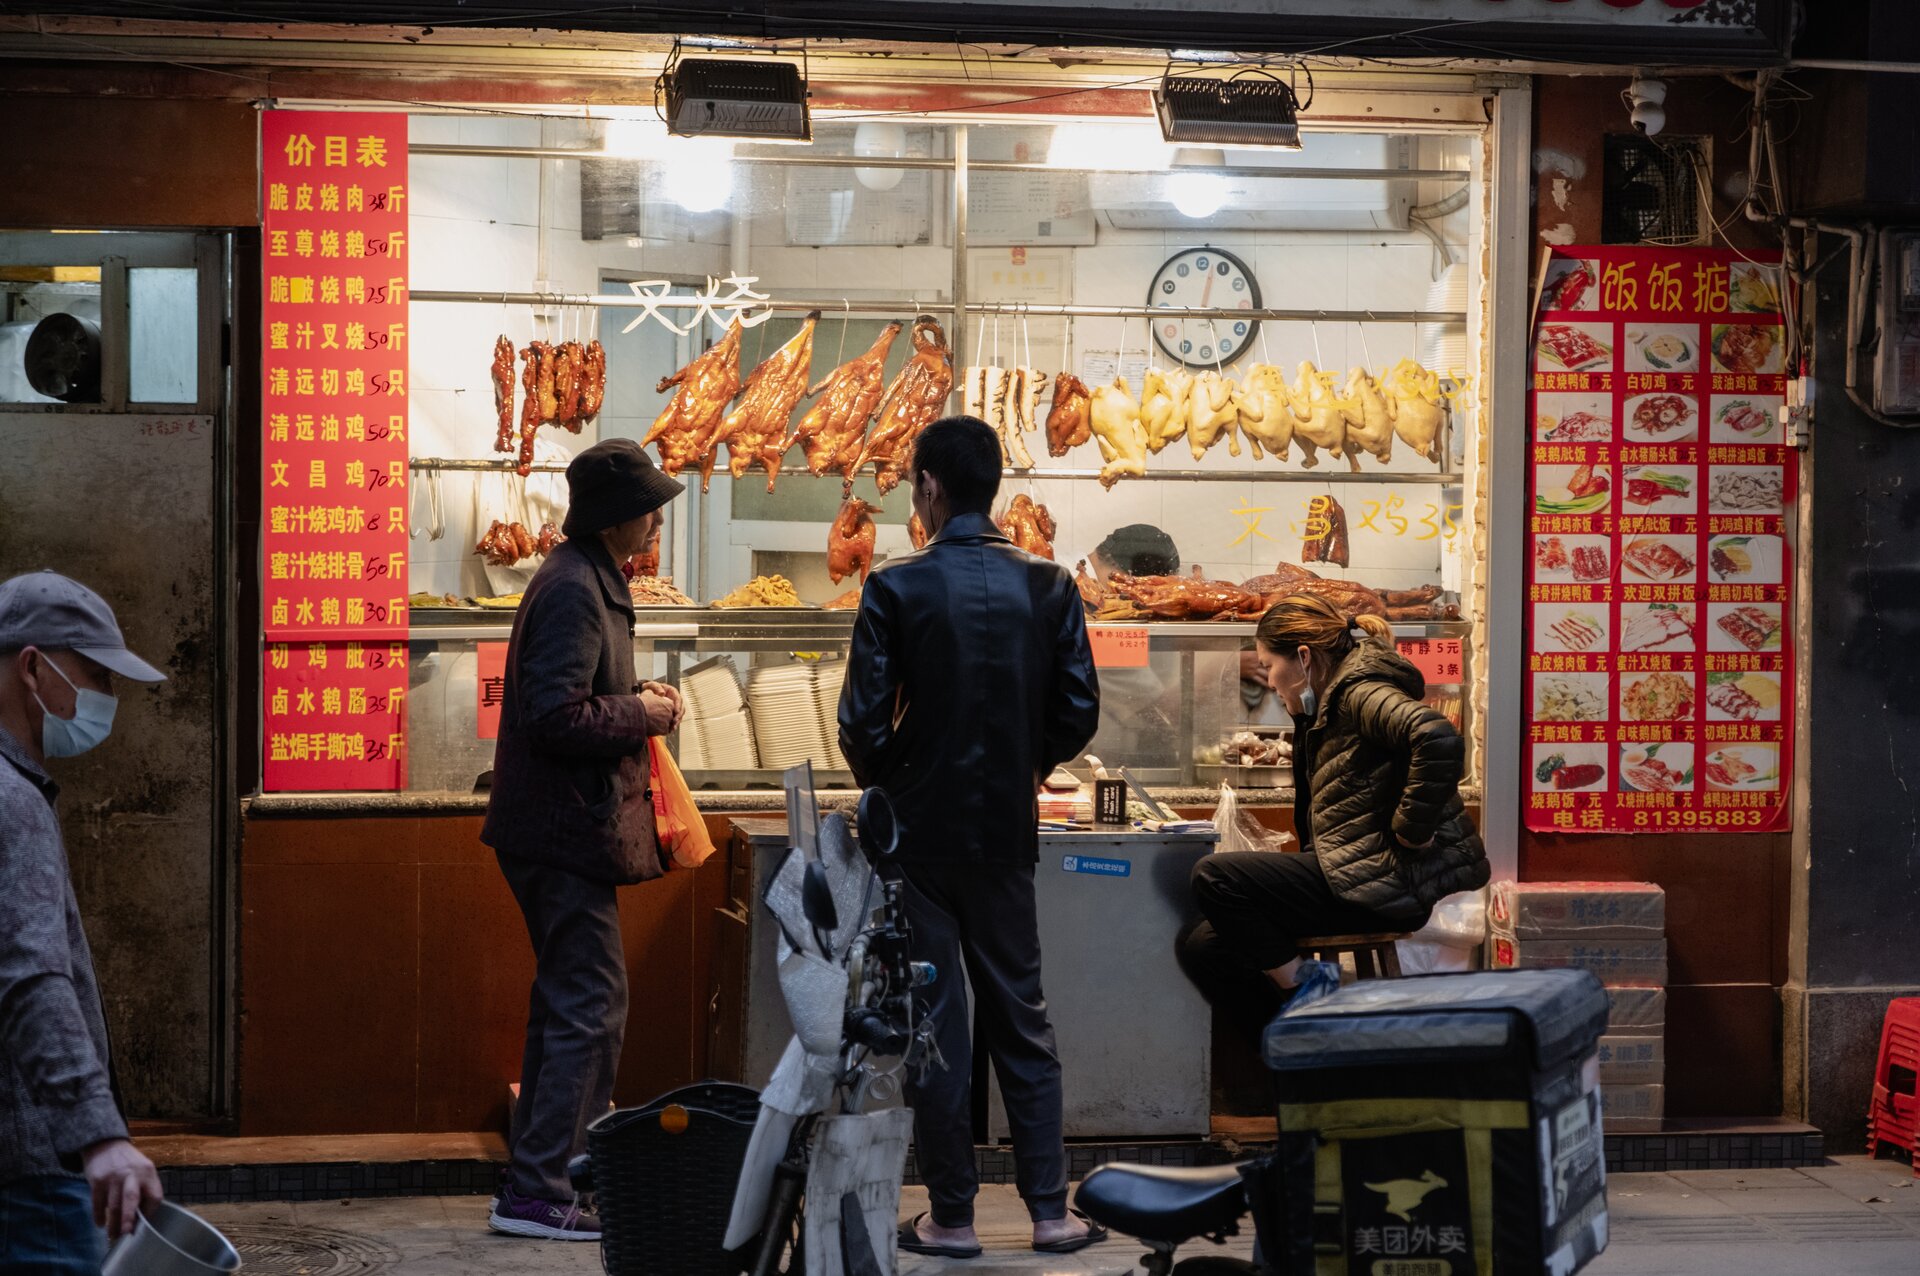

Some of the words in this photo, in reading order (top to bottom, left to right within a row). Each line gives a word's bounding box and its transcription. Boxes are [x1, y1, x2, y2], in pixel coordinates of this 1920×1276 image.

[284, 134, 388, 168] 价目表
[621, 270, 774, 336] 叉烧
[1602, 261, 1728, 314] 饭饭掂
[1634, 811, 1761, 826] 81395883
[1355, 1226, 1467, 1254] 美团外卖
